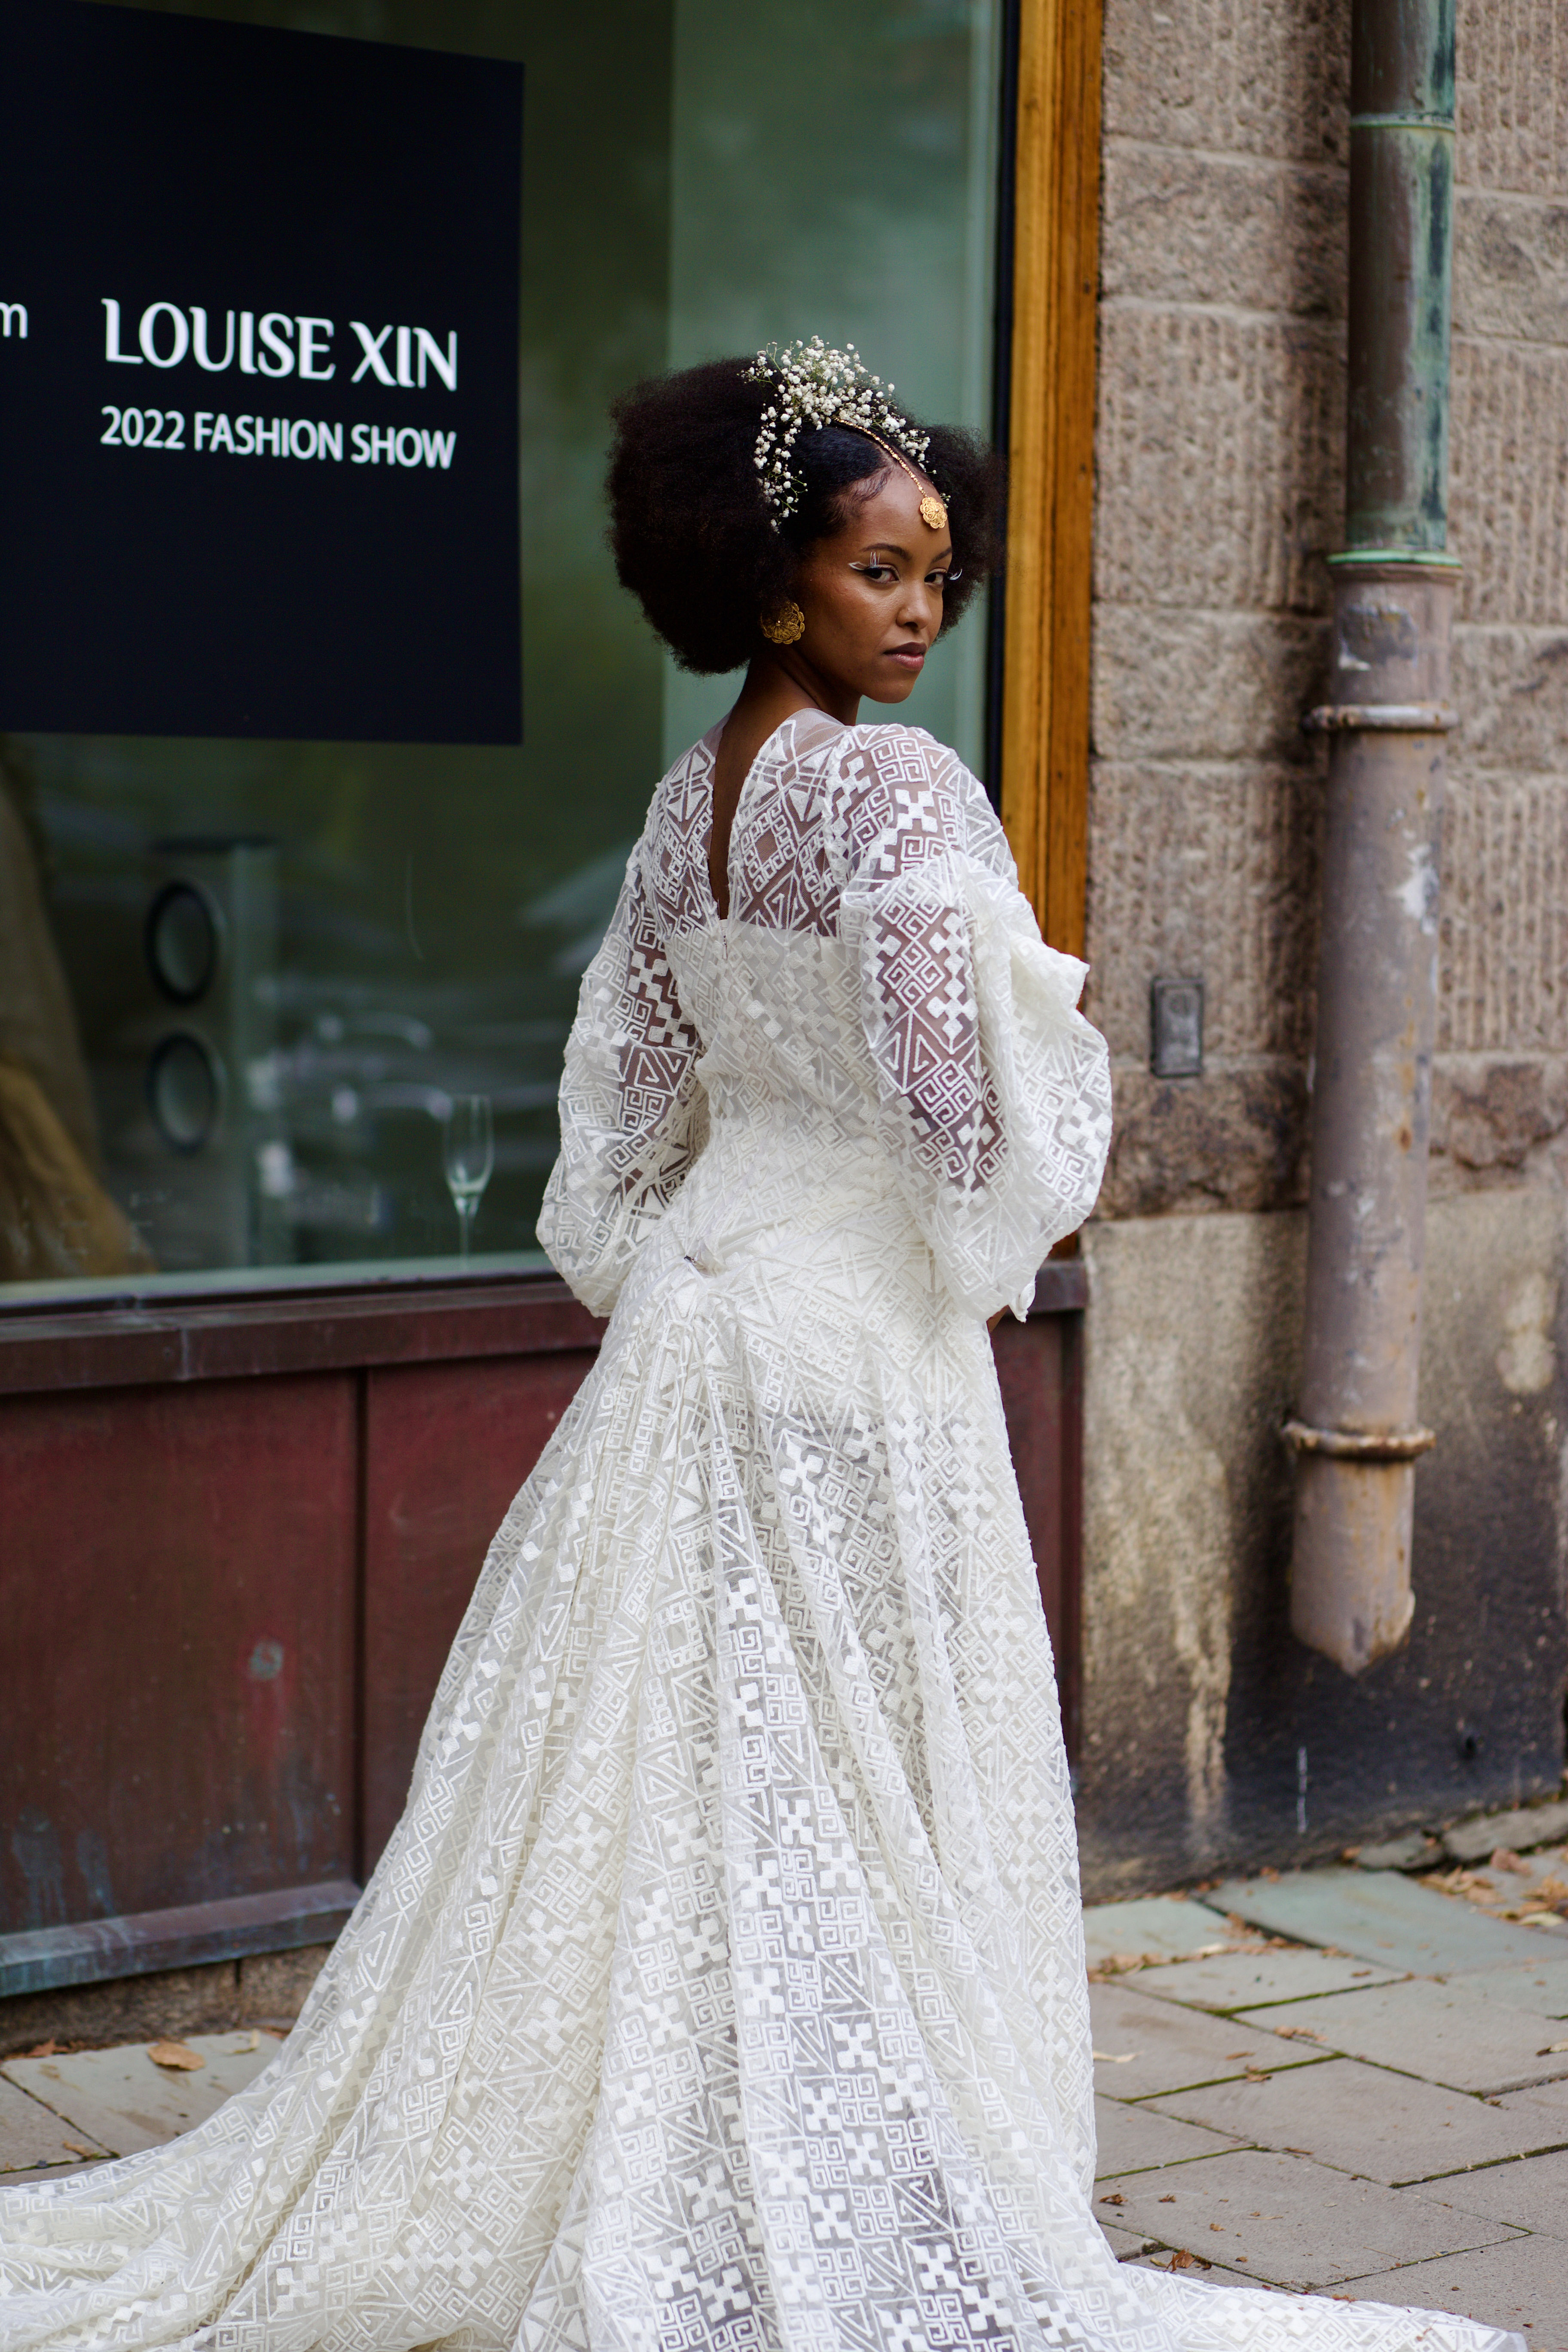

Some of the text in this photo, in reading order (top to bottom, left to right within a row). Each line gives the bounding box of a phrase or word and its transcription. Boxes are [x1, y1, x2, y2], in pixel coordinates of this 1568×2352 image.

[101, 298, 457, 391] LOUISE XIN
[100, 406, 456, 469] 2022 FASHION SHOW
